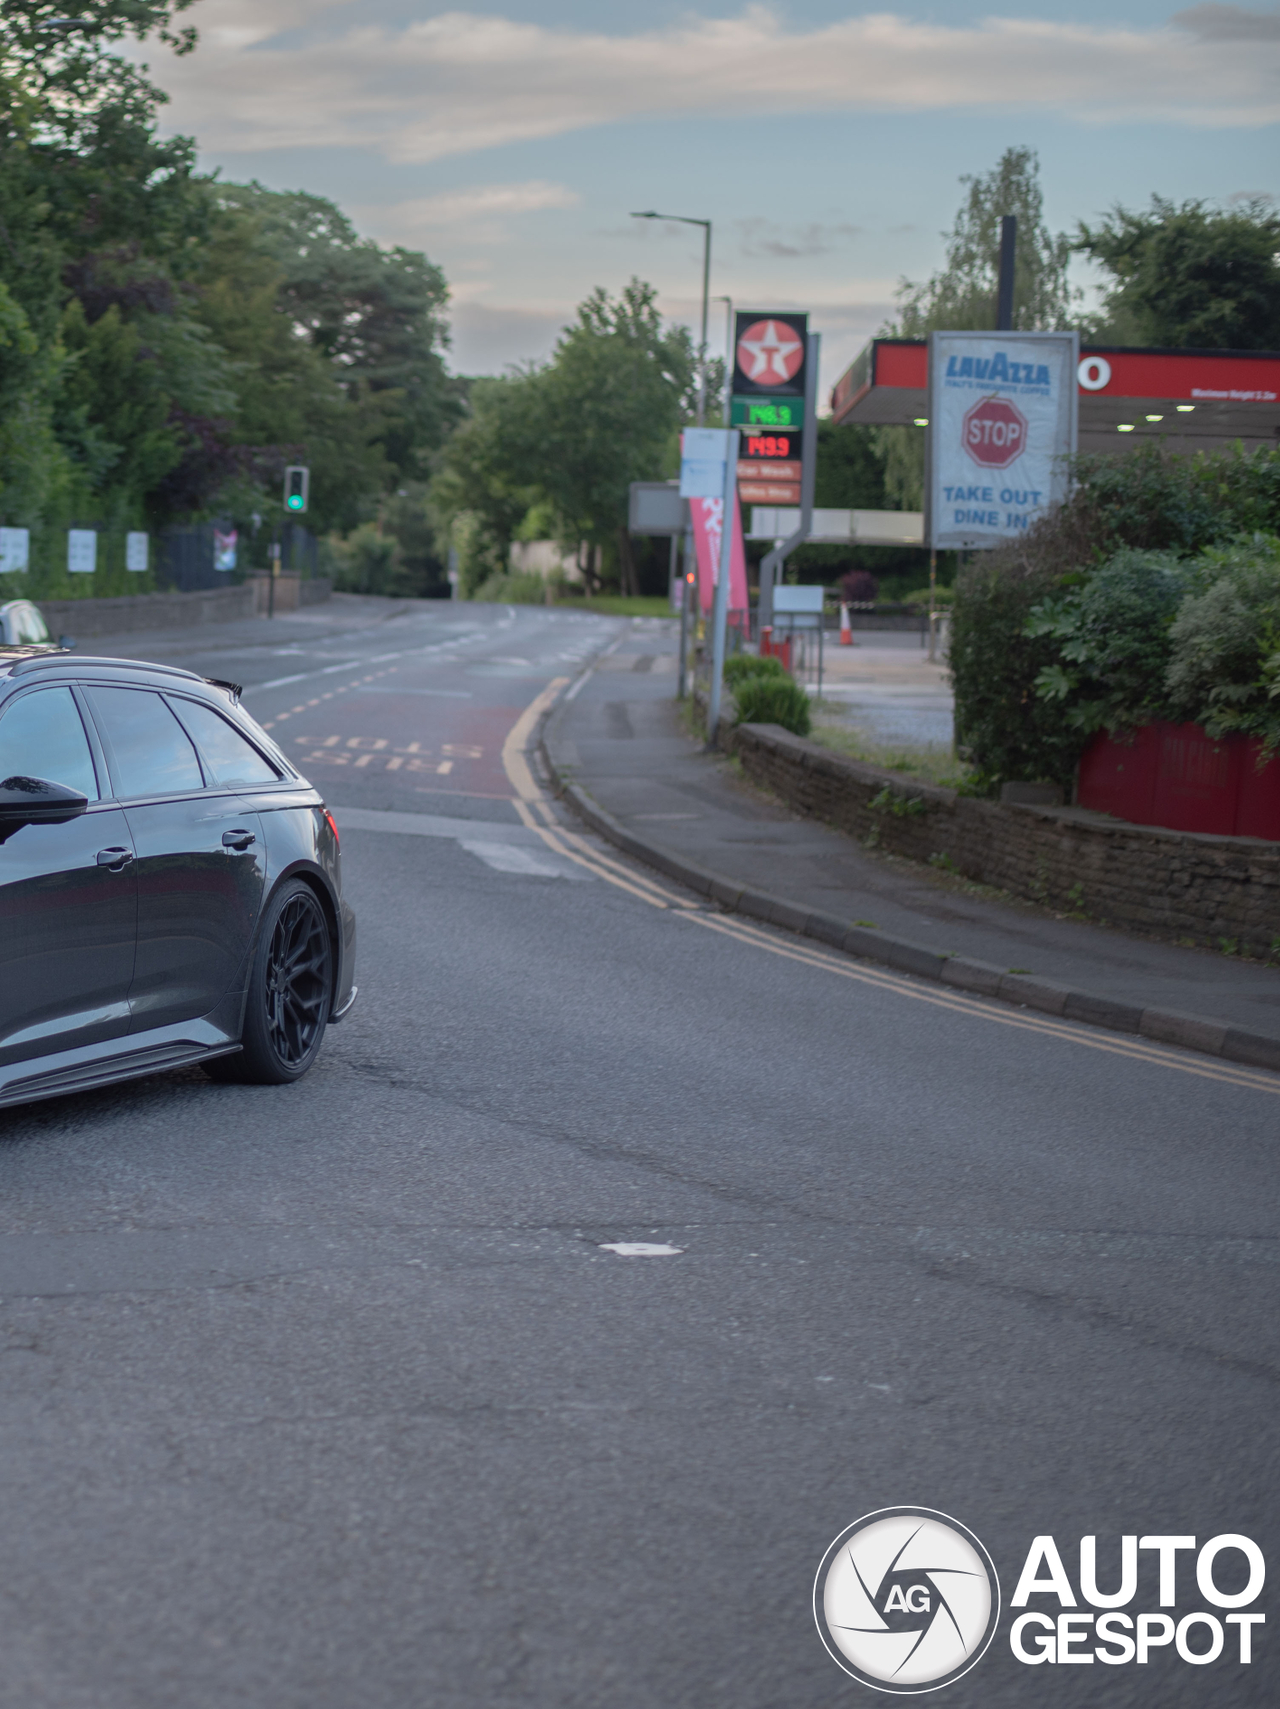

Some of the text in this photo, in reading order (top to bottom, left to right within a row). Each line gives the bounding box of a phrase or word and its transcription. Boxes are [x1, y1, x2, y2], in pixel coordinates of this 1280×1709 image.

[945, 352, 1051, 386] LAVAZZA
[970, 419, 1020, 447] STOP
[943, 486, 1043, 506] TAKE OUT
[954, 509, 1028, 529] DINE IN
[294, 735, 484, 758] STOP
[300, 750, 454, 775] BUS
